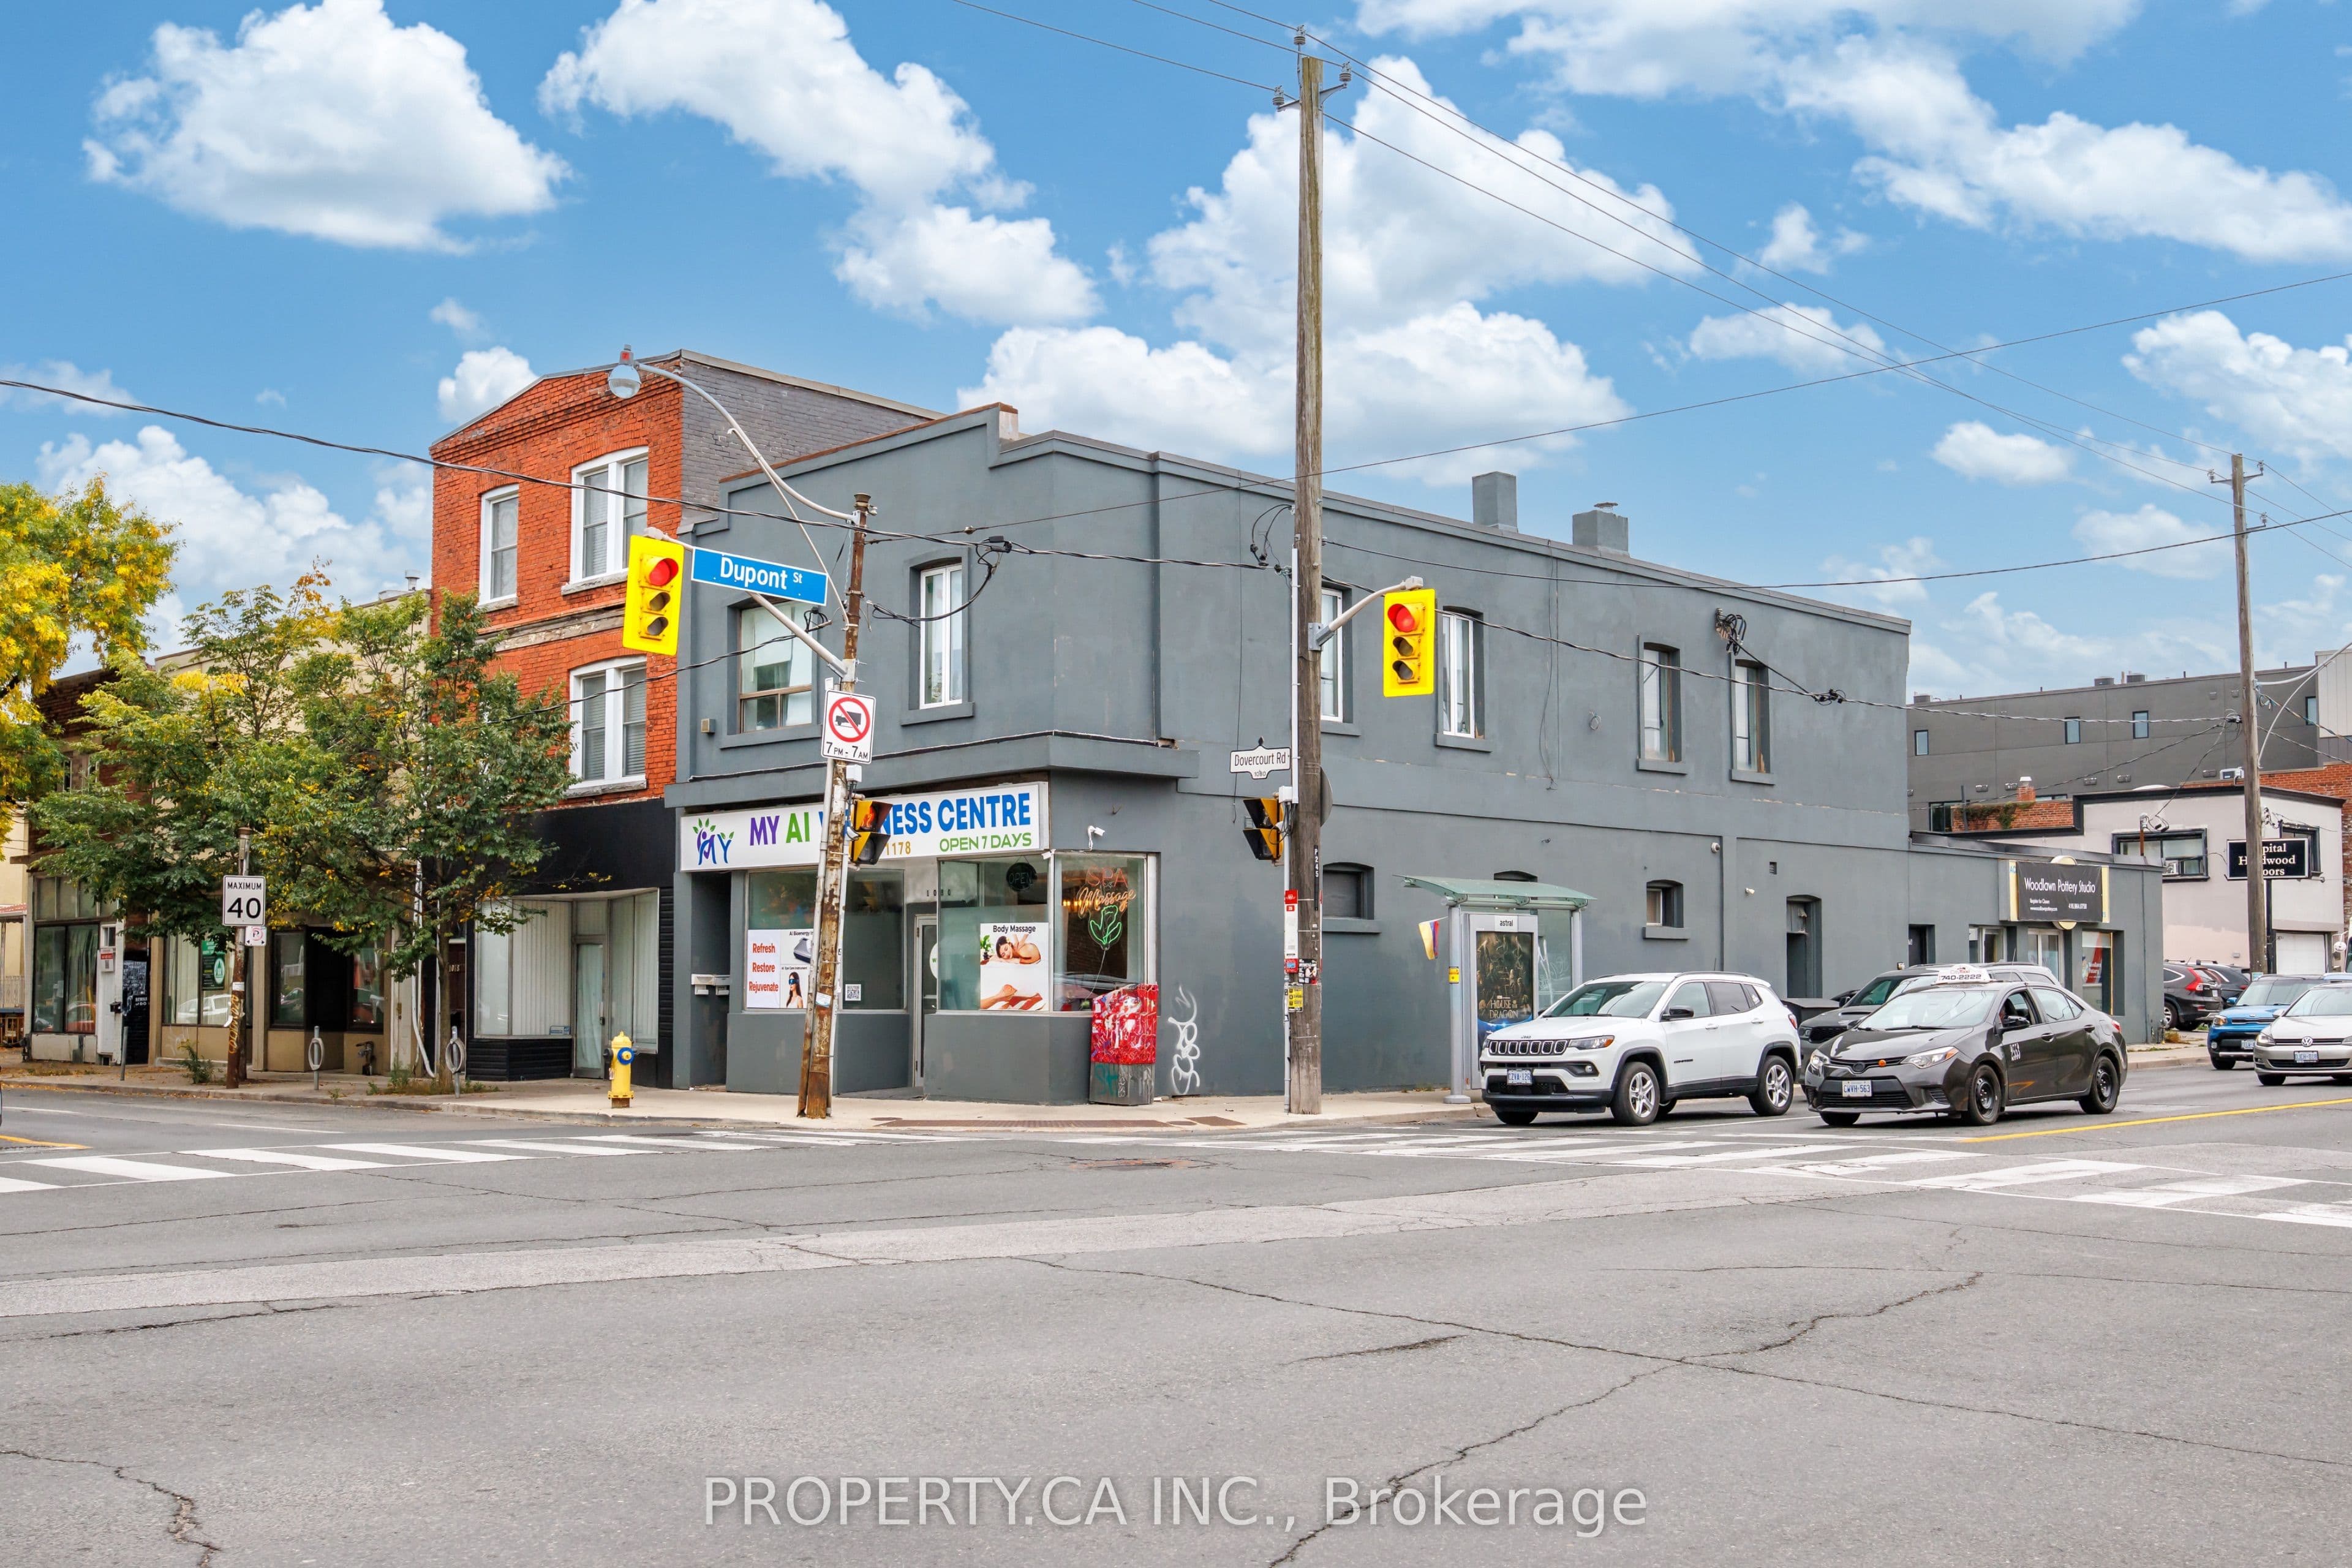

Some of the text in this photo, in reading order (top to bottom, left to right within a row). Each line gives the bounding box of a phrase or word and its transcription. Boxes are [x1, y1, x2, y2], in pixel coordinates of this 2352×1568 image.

[720, 557, 803, 590] Dupont St
[826, 741, 833, 754] 7
[834, 747, 843, 756] PM
[852, 745, 859, 758] 7
[1234, 752, 1286, 767] Dovercourt Rd
[750, 815, 780, 846] MY
[786, 812, 810, 843] AI
[938, 793, 1030, 832] CENTRE
[940, 832, 1032, 852] OPEN 7 DAYS
[2238, 854, 2296, 865] Hdwood
[1009, 872, 1033, 884] OPEN
[1087, 865, 1128, 887] SPA
[2024, 877, 2095, 895] Woodlawn Pottery Studio
[227, 897, 261, 919] 40
[1078, 887, 1136, 914] Massage
[993, 925, 1036, 934] Body Massage
[752, 943, 775, 953] Refresh
[752, 962, 775, 973] Restore
[749, 981, 778, 993] Rejuvenate
[1491, 1000, 1511, 1009] HOUSE
[1489, 1009, 1518, 1019] DRAGON
